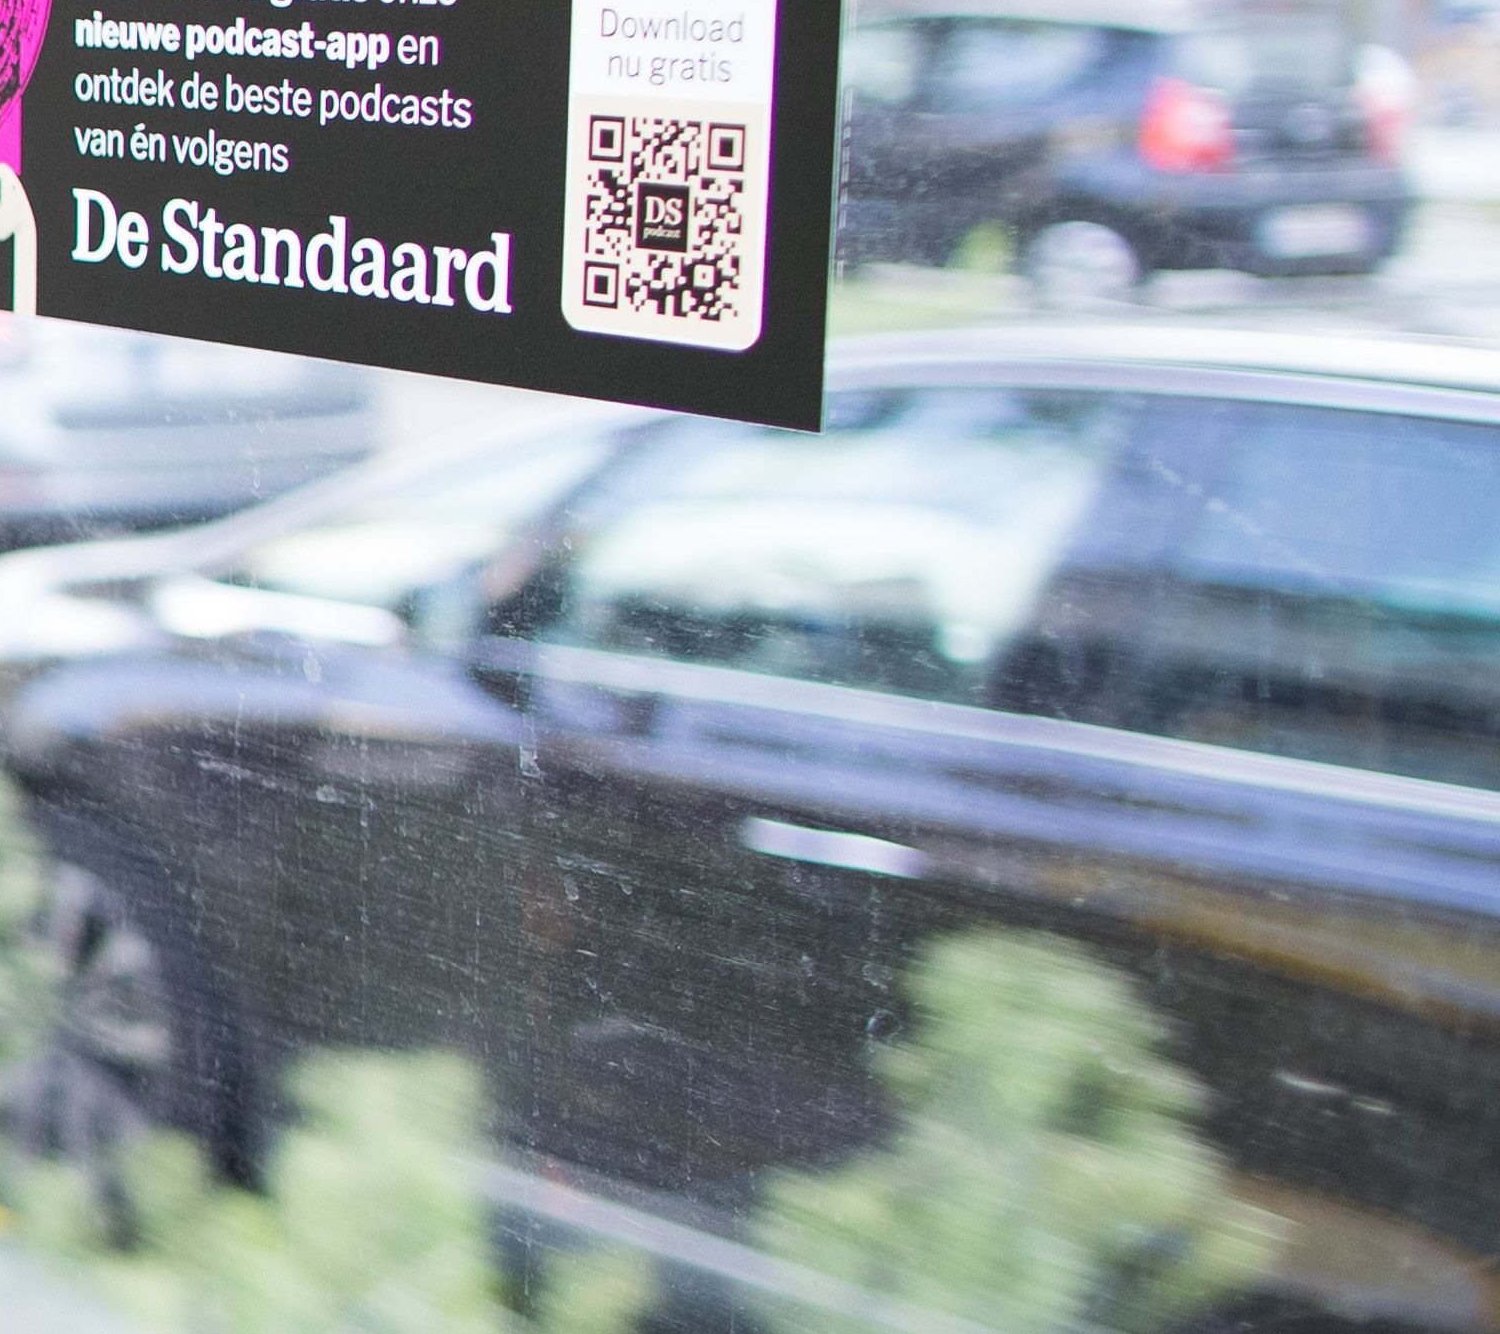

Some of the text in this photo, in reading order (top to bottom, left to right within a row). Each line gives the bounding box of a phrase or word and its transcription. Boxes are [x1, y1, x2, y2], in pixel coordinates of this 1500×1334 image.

[75, 11, 439, 70] nieuwe podcast-app en
[600, 8, 745, 42] Download
[608, 53, 732, 86] nu gratis
[74, 68, 473, 128] ontdek de beste podcasts
[74, 123, 289, 175] van én volgens
[645, 195, 682, 225] DS
[71, 187, 512, 313] De Standaard
